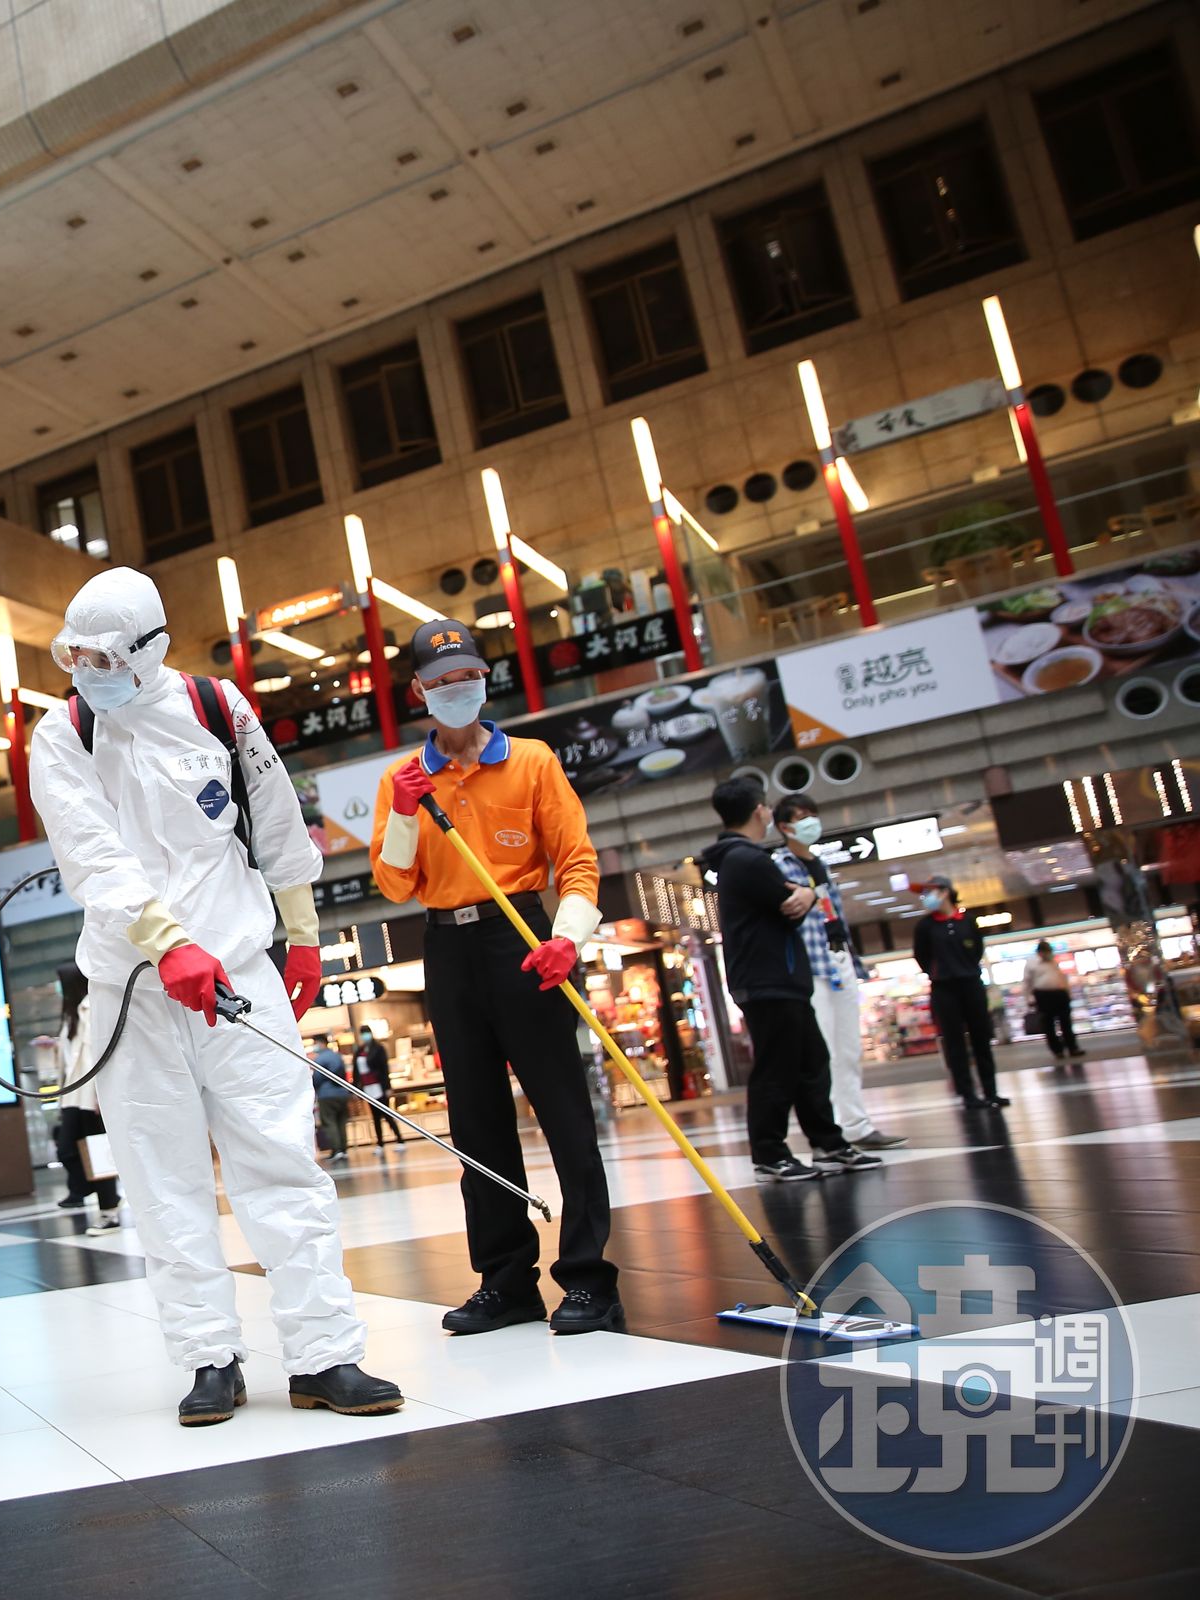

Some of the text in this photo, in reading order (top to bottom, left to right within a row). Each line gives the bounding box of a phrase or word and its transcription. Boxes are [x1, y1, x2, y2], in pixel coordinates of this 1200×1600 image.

[436, 643, 462, 653] sincere
[842, 680, 938, 711] Only pho you
[798, 728, 822, 745] 2F
[178, 754, 231, 777] 信實集
